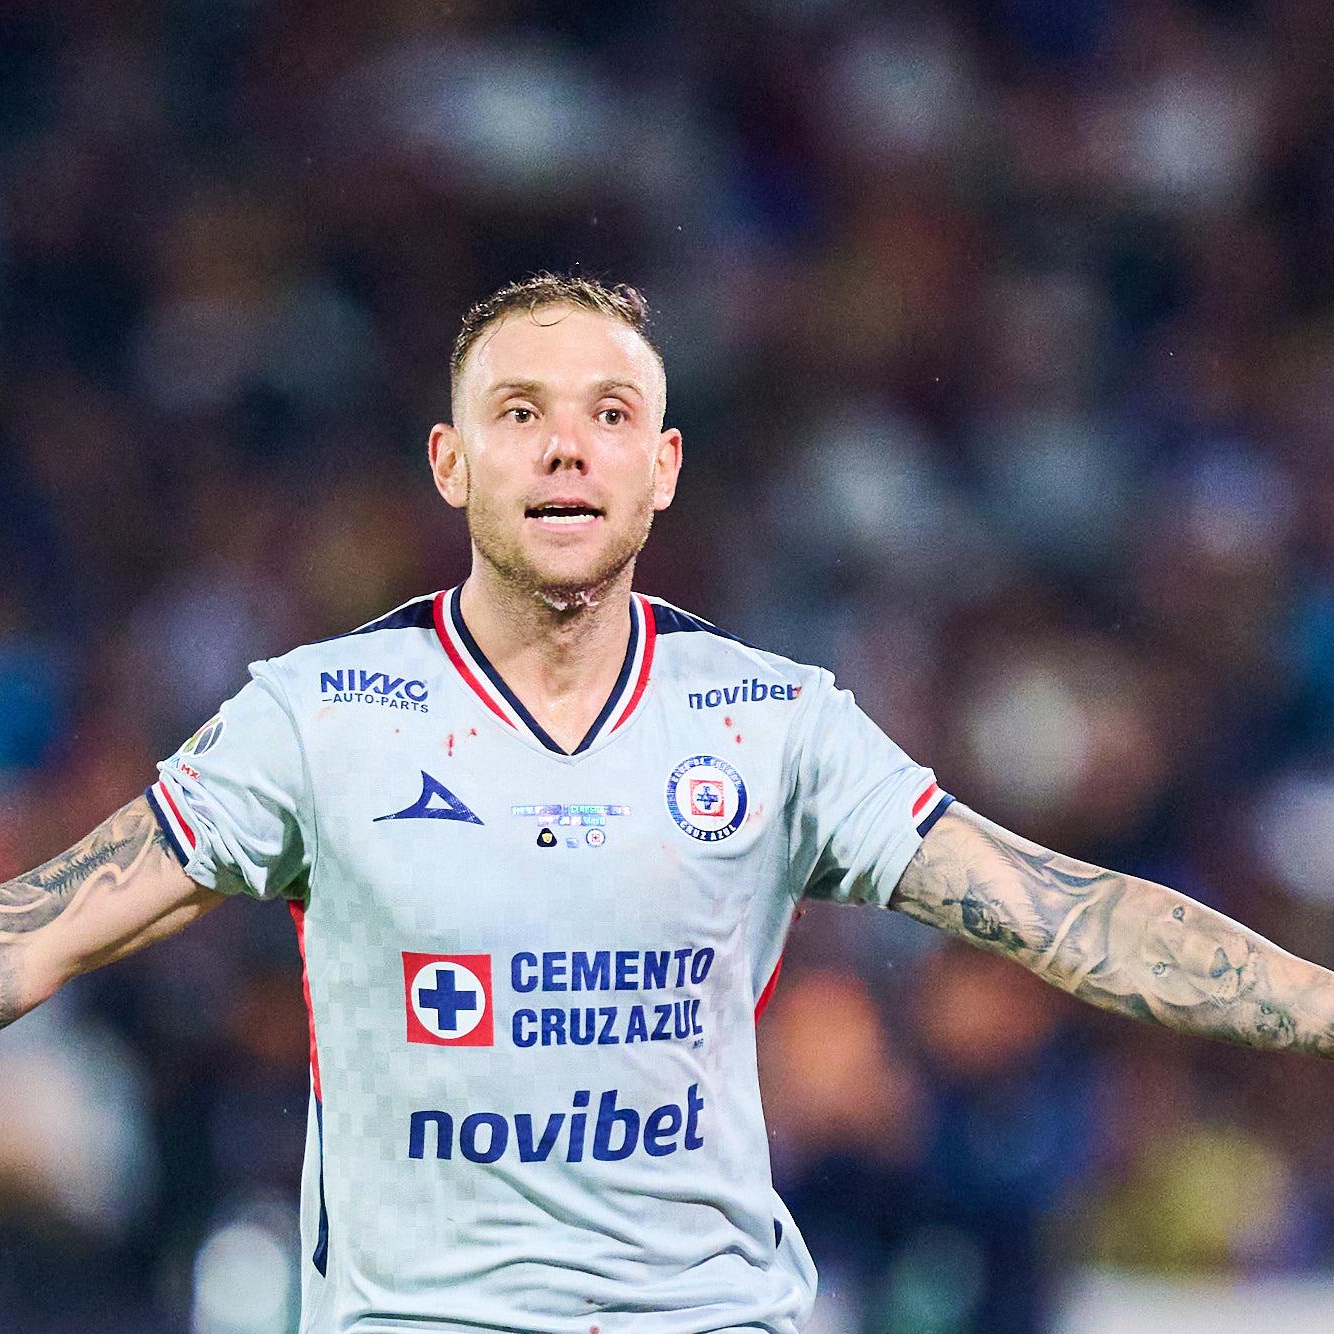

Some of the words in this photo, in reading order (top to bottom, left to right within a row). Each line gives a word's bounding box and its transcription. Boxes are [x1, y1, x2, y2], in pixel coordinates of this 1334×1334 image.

[688, 678, 802, 709] novibet
[710, 824, 737, 841] AZUL
[511, 947, 716, 993] CEMENTO
[512, 1006, 620, 1048] CRUZ
[625, 999, 704, 1045] AZUL
[408, 1083, 705, 1164] novibet
